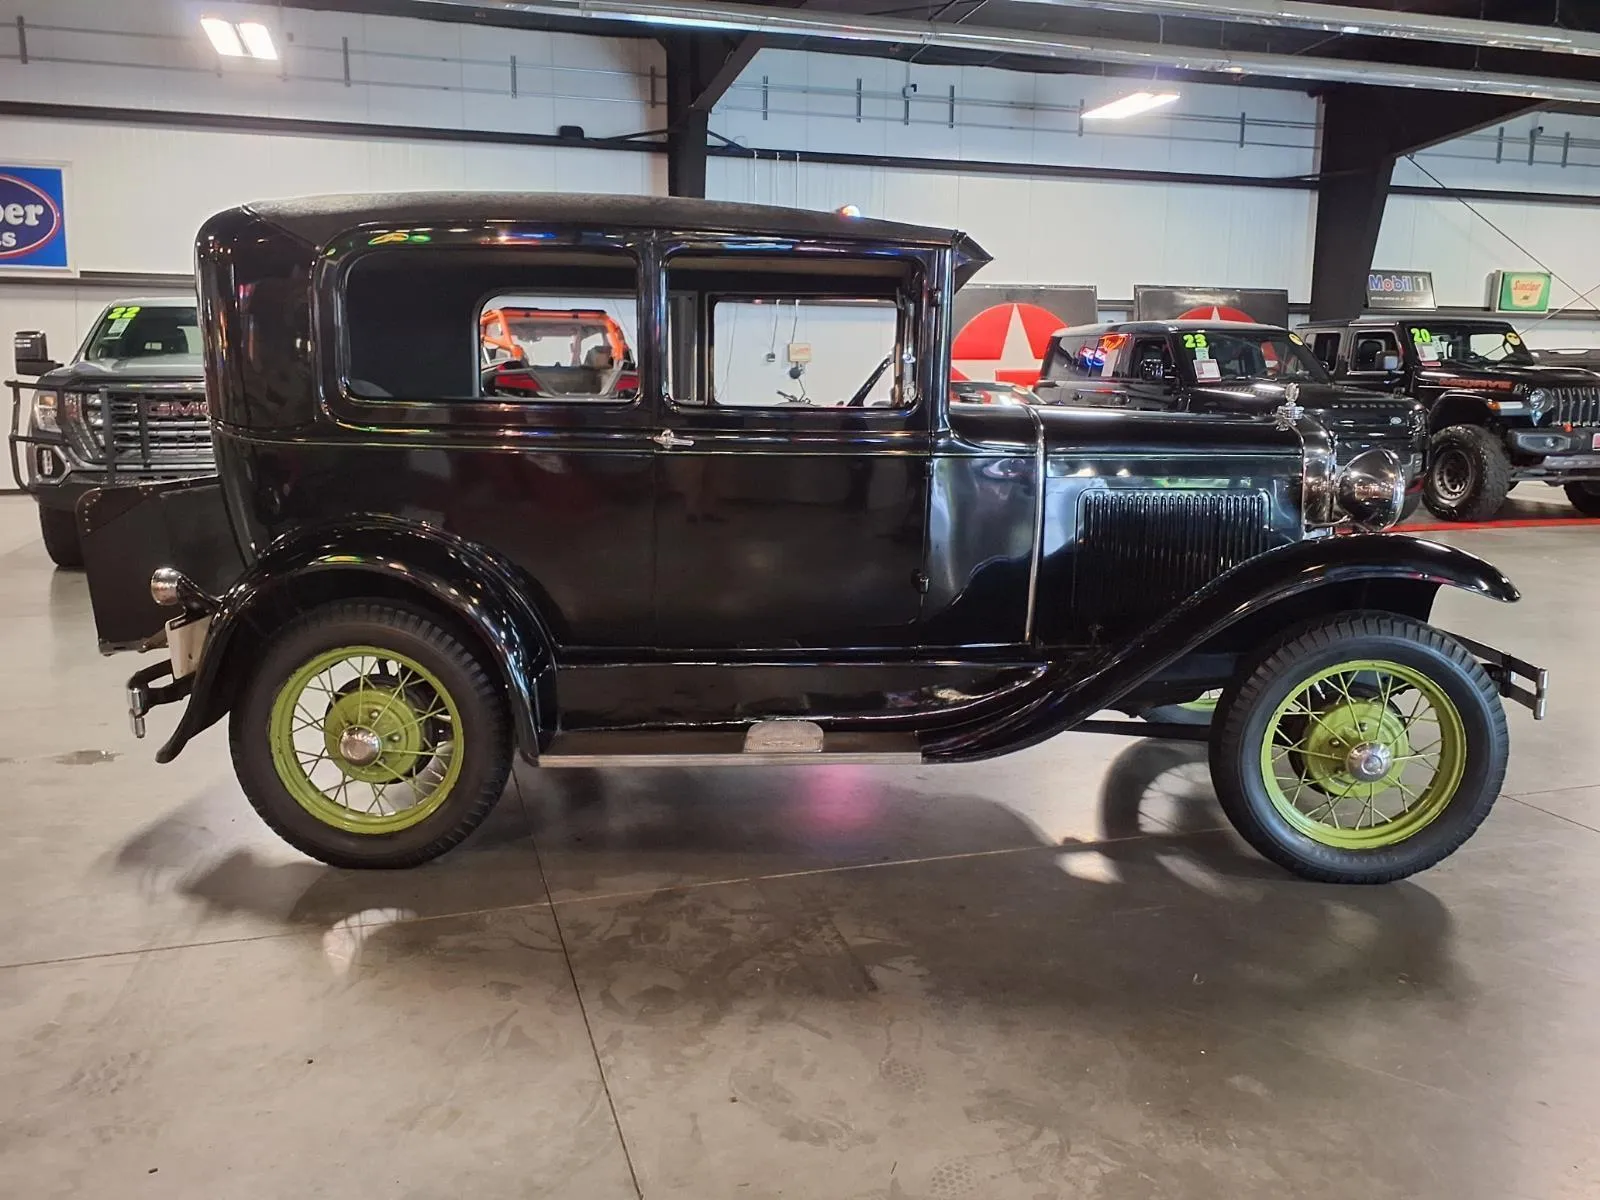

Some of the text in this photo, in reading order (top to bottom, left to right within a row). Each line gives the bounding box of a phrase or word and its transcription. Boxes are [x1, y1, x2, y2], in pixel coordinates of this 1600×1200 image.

[0, 203, 44, 226] er
[1368, 274, 1427, 292] Mobil 1
[108, 306, 141, 320] 22
[1183, 333, 1207, 348] 23
[1411, 328, 1431, 343] 20
